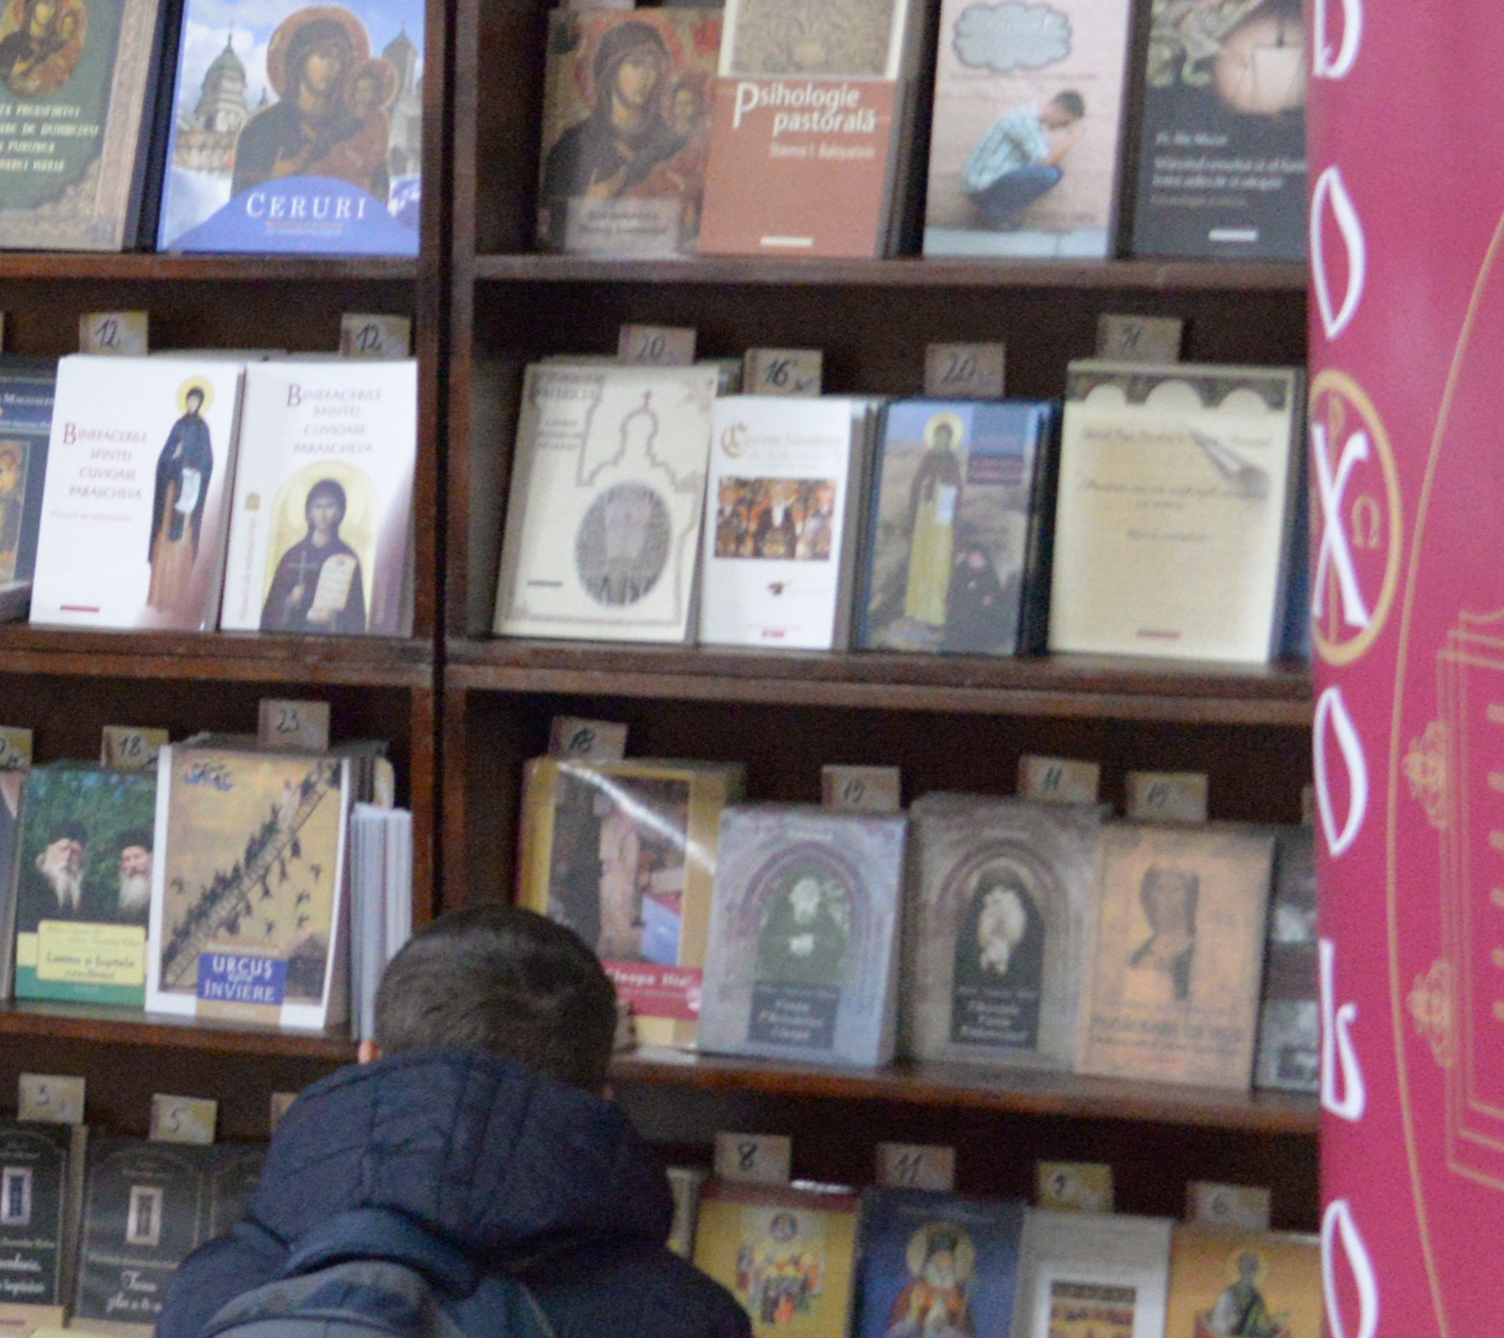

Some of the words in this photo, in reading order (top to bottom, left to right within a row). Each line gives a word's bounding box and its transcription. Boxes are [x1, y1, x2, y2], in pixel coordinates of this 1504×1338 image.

[733, 82, 862, 129] Psihologie
[772, 108, 876, 137] pastorală
[246, 192, 368, 221] CERURI
